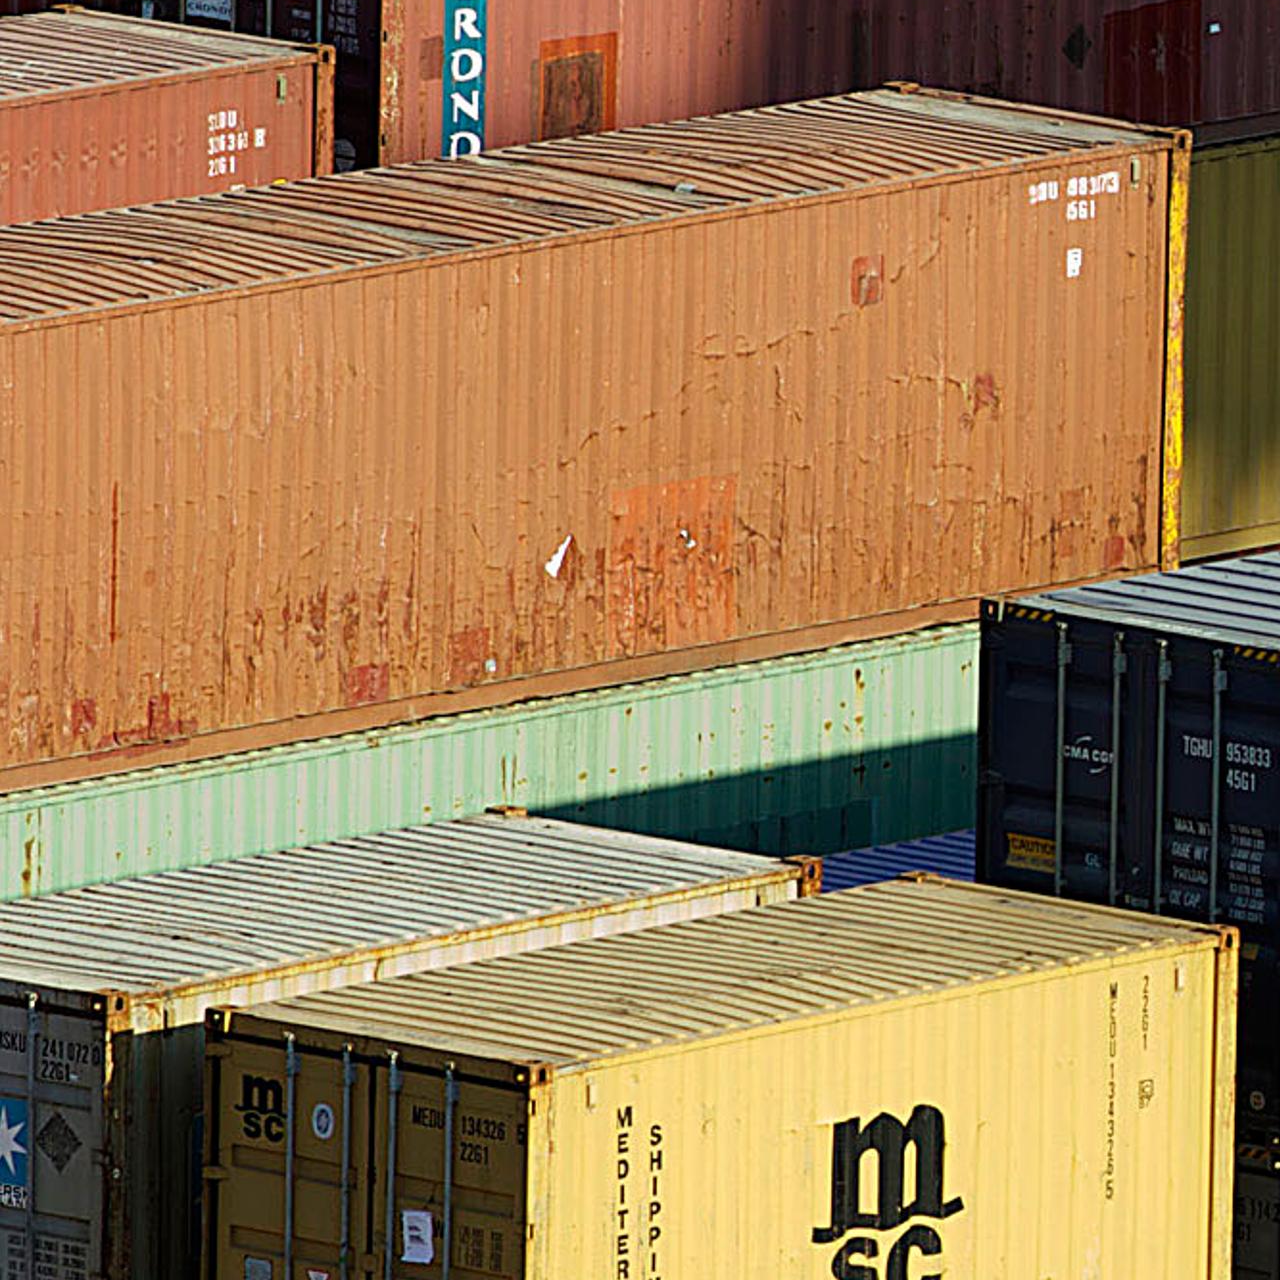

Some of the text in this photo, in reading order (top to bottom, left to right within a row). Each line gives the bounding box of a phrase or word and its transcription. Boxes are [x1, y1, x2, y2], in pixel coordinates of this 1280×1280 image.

[1063, 745, 1089, 764] CMA
[1183, 734, 1213, 760] TGHU
[1225, 741, 1271, 769] 953833
[1225, 768, 1257, 794] 45G1
[1011, 836, 1056, 857] CAUTIO
[412, 1105, 445, 1130] MEDU
[460, 1114, 506, 1143] 134326
[459, 1141, 489, 1166] 22G1
